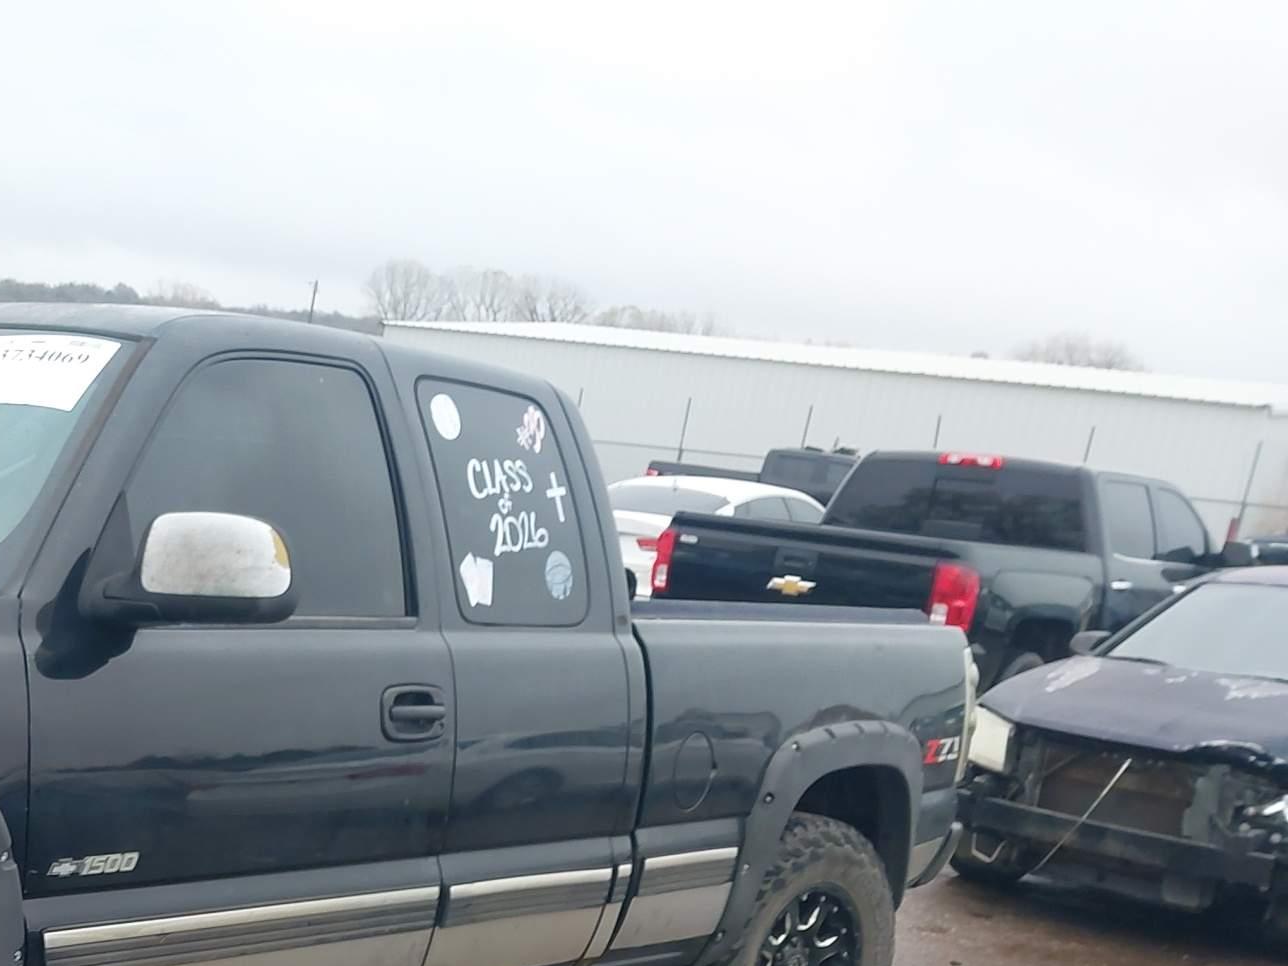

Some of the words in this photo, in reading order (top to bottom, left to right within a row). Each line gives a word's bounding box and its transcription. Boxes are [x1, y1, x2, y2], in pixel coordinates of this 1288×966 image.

[467, 458, 533, 499] CLASS
[490, 511, 549, 557] 2026
[923, 736, 961, 765] Z71
[80, 852, 140, 876] 1500
